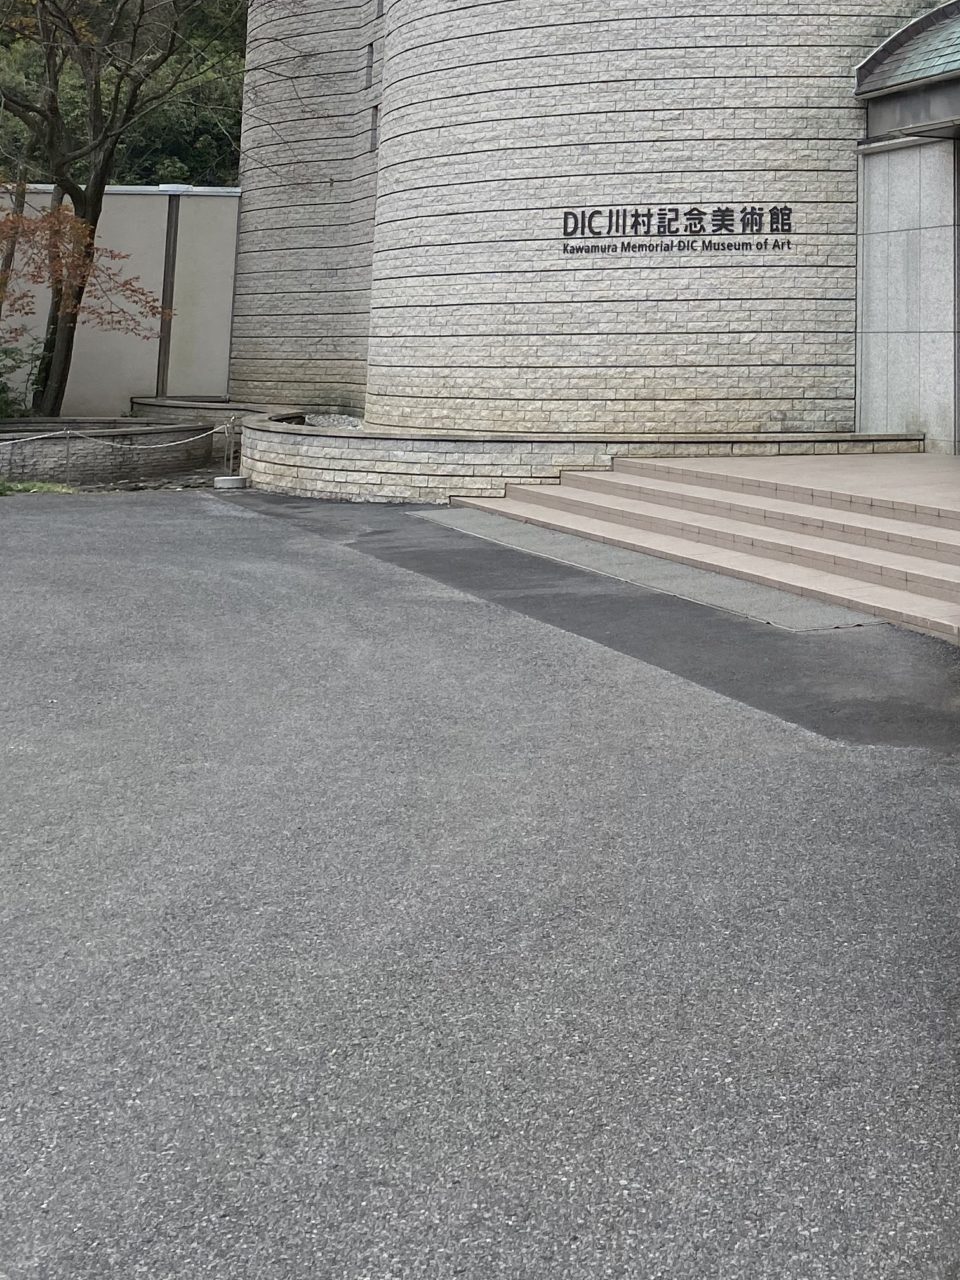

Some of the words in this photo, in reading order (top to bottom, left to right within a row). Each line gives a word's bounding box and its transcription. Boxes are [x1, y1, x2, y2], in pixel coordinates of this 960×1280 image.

[562, 205, 792, 236] DIC川村記念美術館
[563, 243, 617, 254] Kawamura
[621, 240, 673, 252] Memorial
[678, 240, 698, 251] DIC
[702, 239, 752, 251] Museum
[755, 238, 769, 250] of
[772, 238, 792, 250] Art
